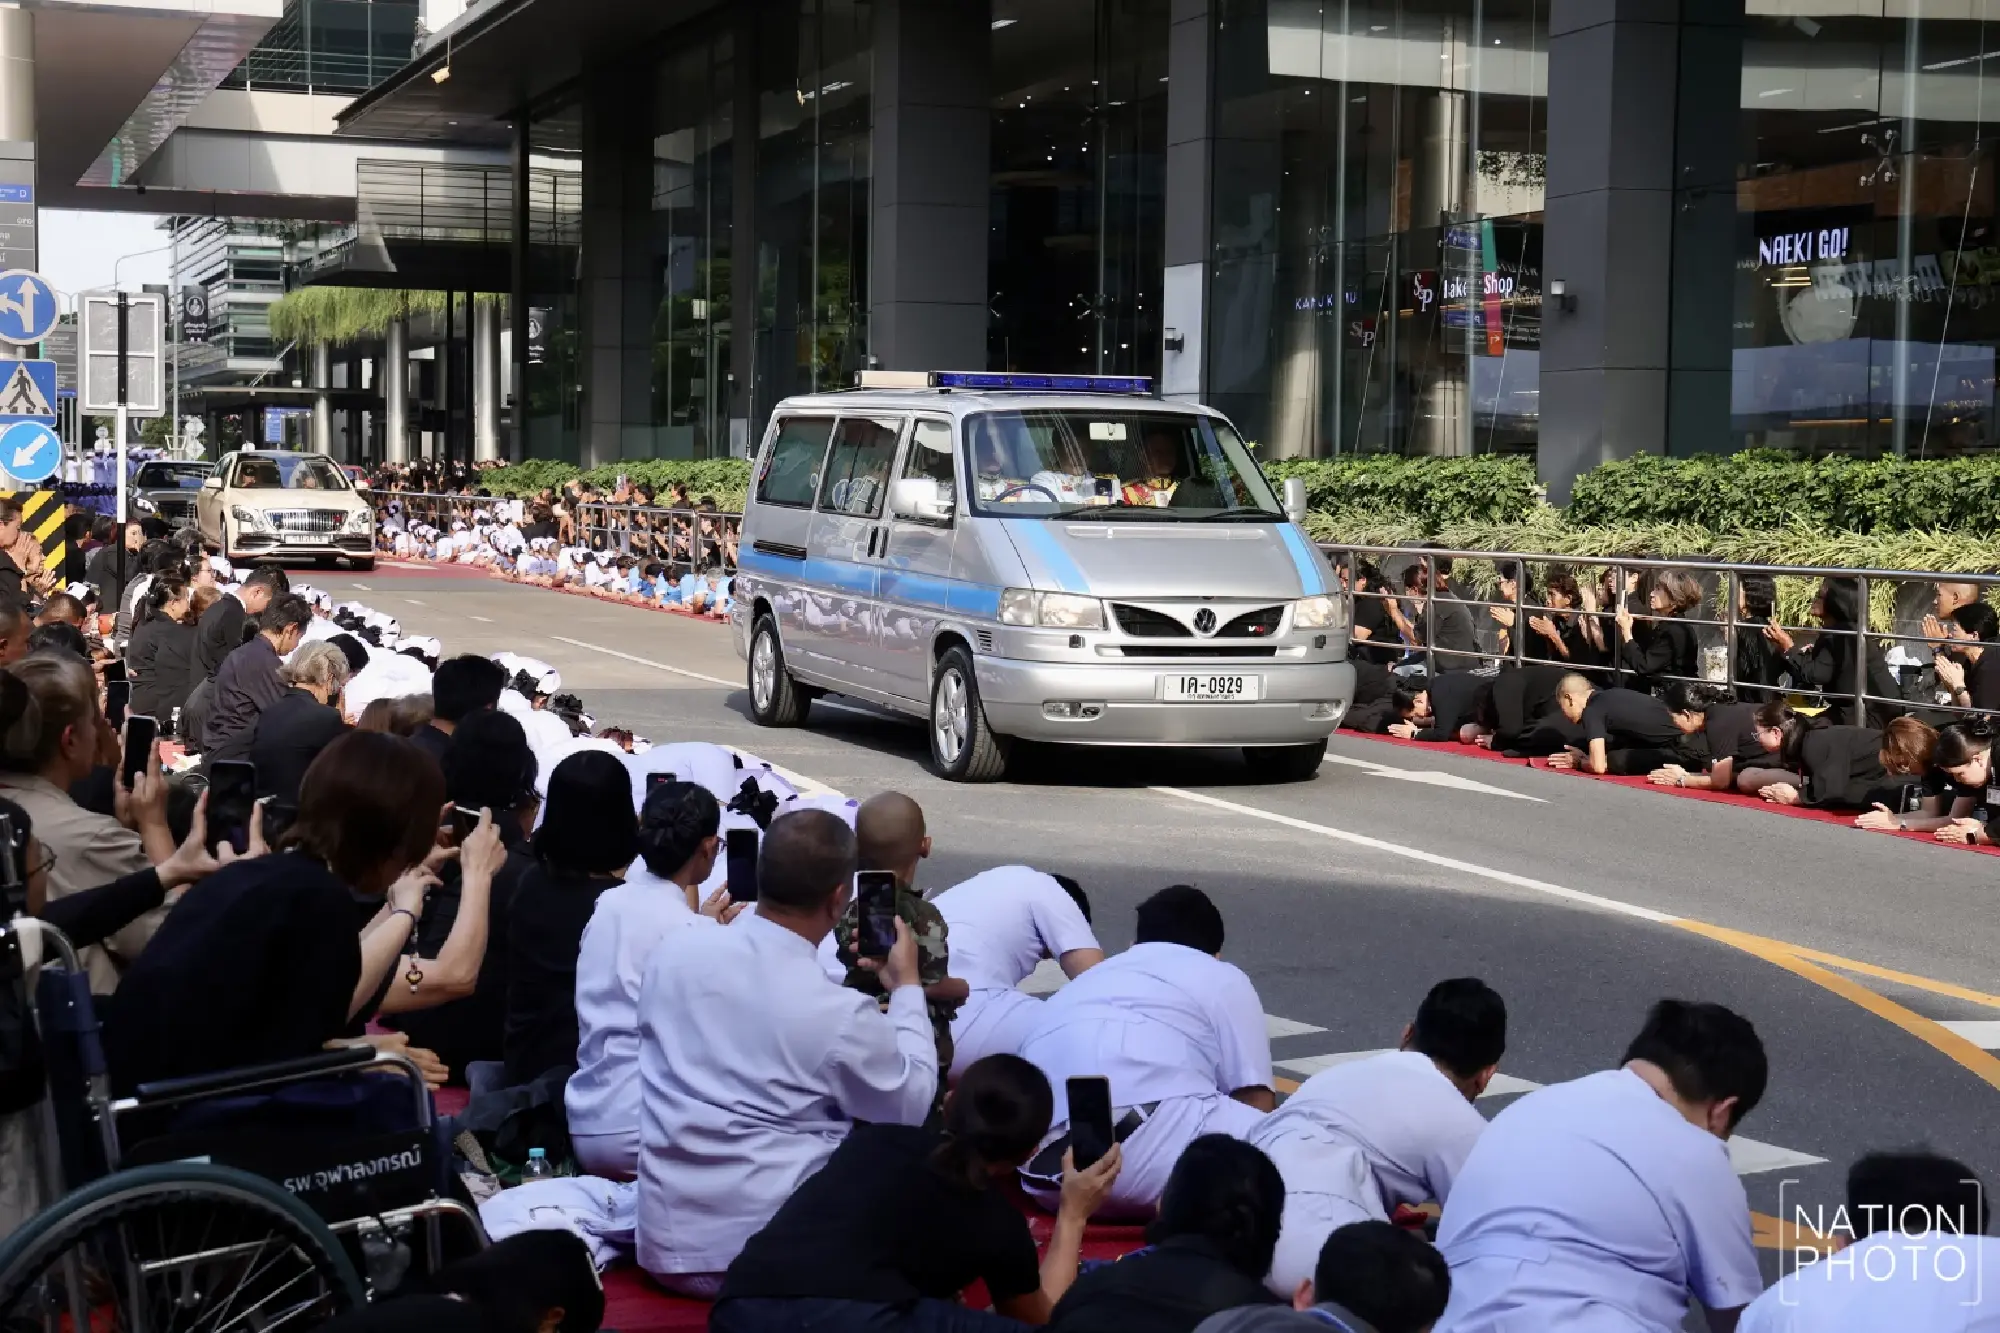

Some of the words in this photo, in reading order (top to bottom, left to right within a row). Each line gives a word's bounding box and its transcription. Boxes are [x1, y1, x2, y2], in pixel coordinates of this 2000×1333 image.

[1759, 232, 1812, 266] NAEKI
[1818, 227, 1849, 259] GO!
[1483, 271, 1513, 298] Shop
